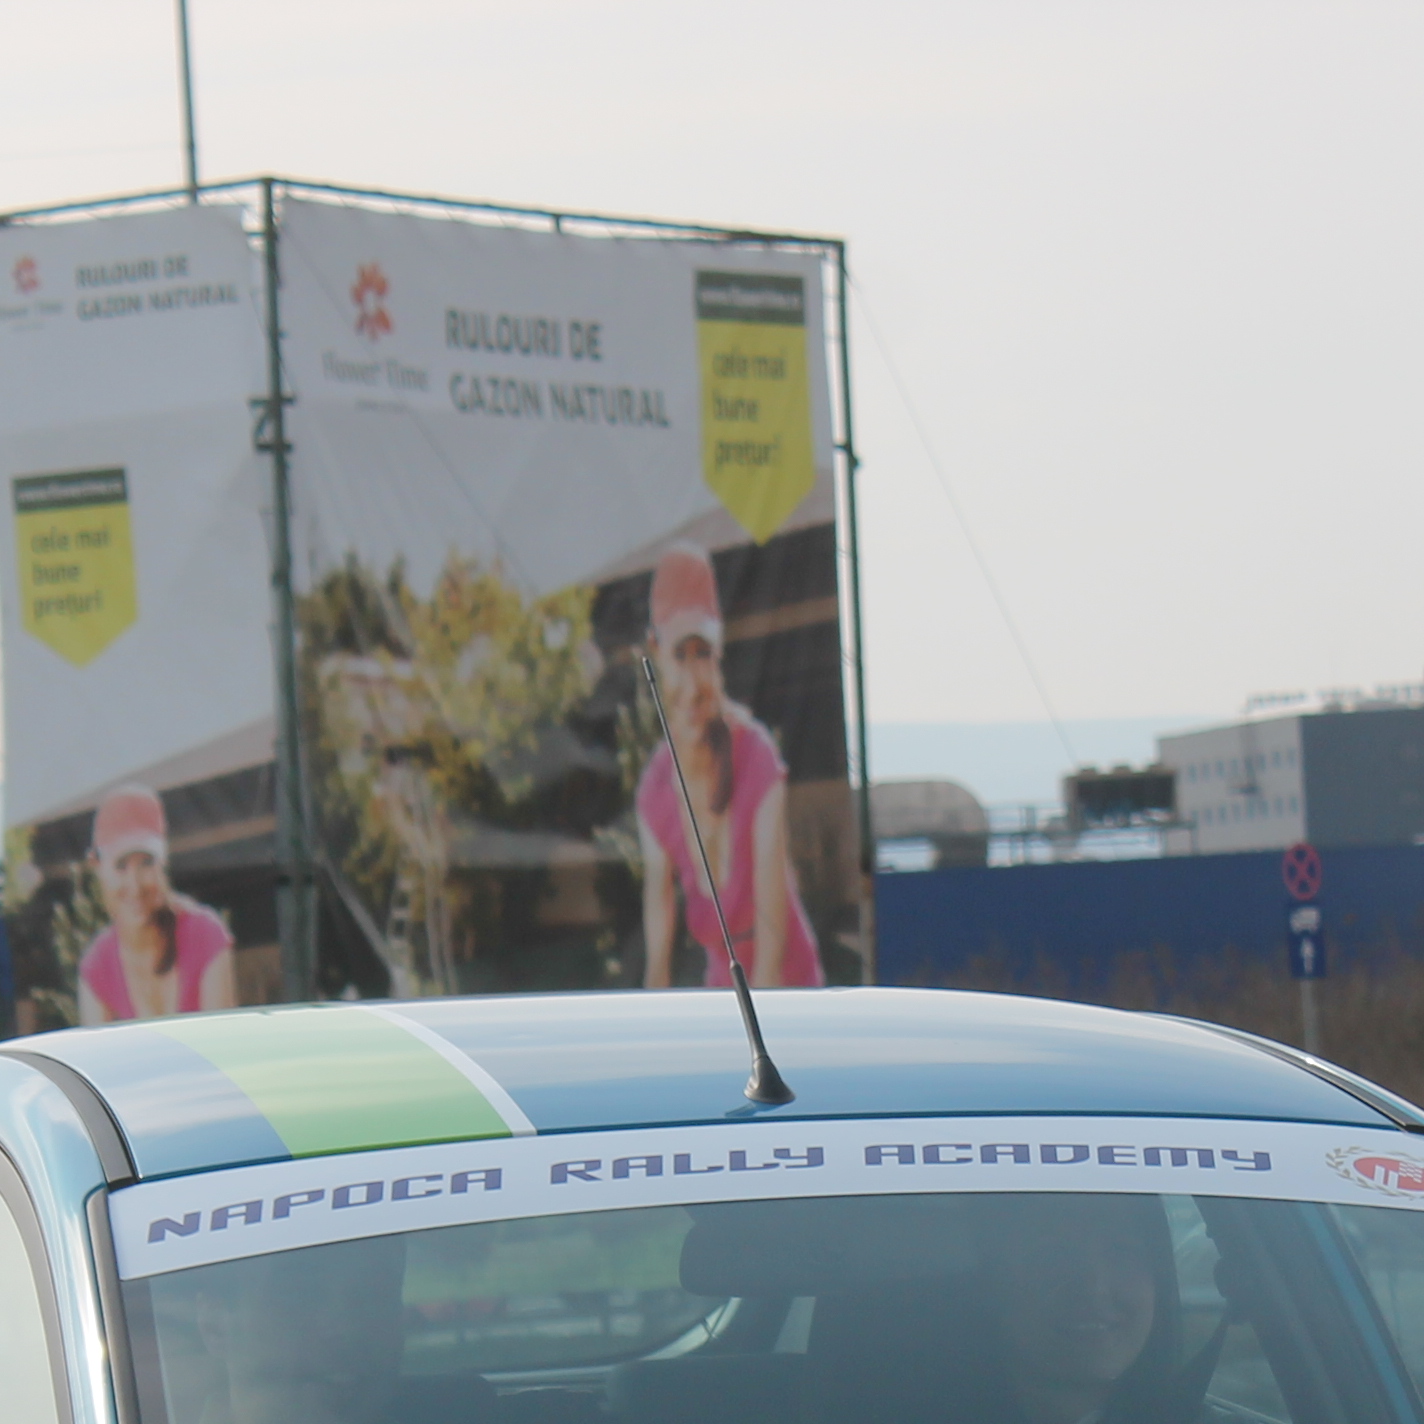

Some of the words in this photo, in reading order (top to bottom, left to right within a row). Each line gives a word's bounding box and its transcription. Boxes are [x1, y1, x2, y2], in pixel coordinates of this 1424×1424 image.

[76, 258, 159, 288] RULOURI
[77, 293, 143, 321] GAZON
[148, 284, 239, 312] NATURAL
[444, 306, 563, 358] RULOURI
[567, 318, 603, 362] DE
[448, 371, 544, 419] GAZON
[547, 382, 672, 430] NATURAL
[145, 1167, 503, 1245] NAPOCA
[548, 1145, 826, 1186] RALLY
[862, 1141, 1274, 1174] ACADEMY
